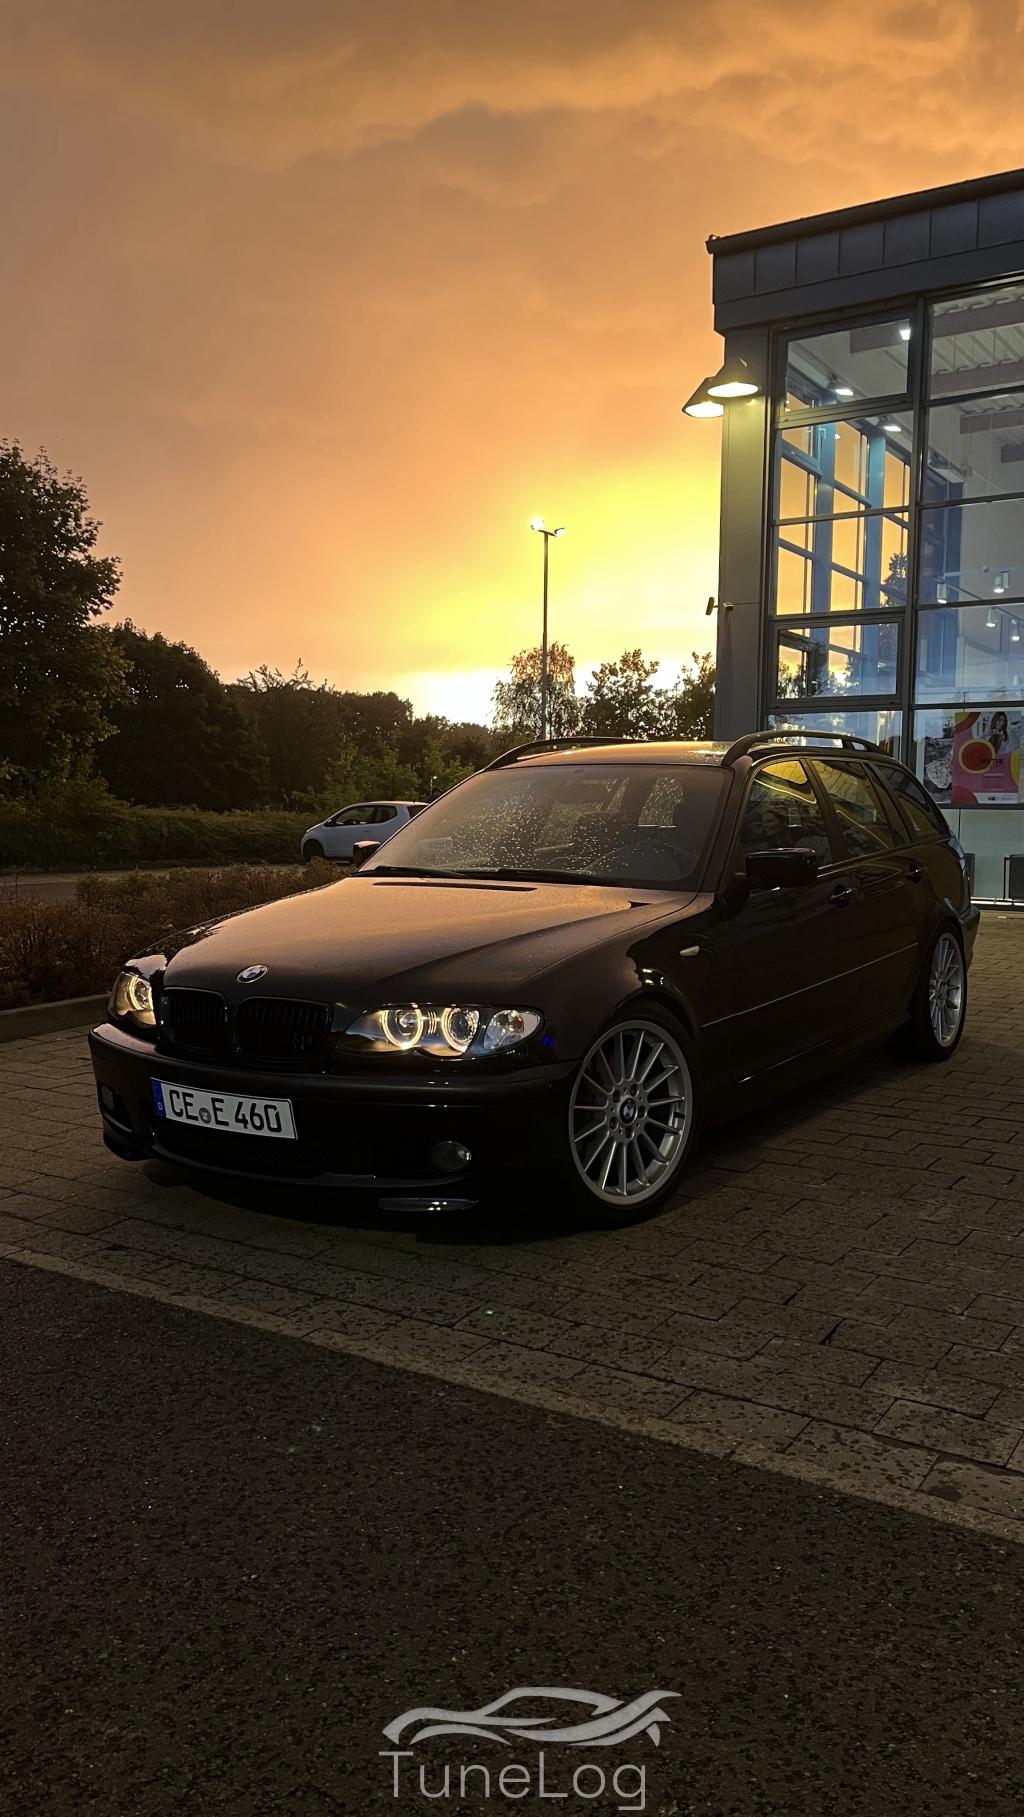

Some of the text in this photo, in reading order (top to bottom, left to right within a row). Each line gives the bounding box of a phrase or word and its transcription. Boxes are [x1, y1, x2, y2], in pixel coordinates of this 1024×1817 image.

[168, 1089, 282, 1133] CE E 460
